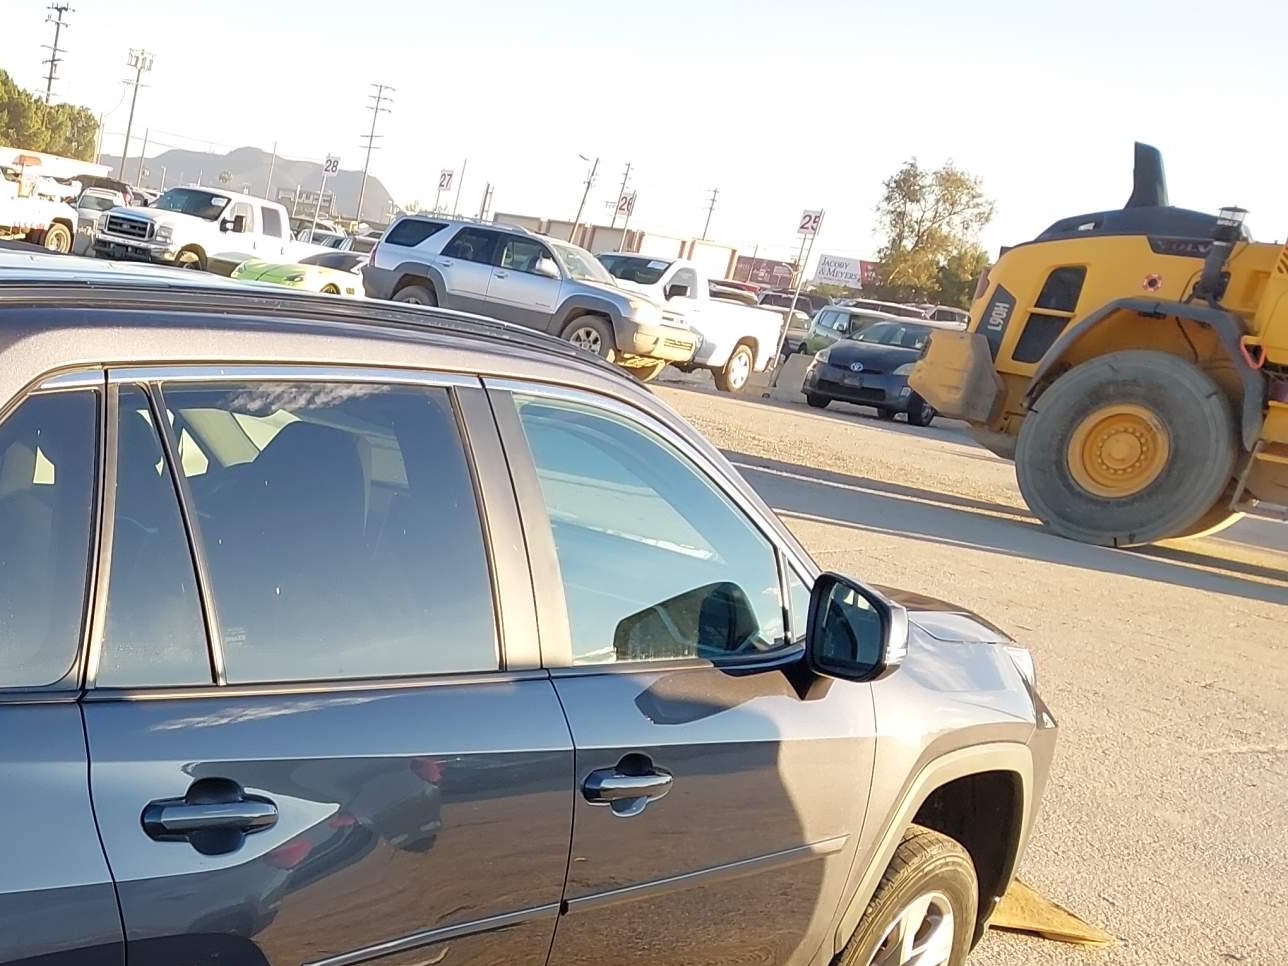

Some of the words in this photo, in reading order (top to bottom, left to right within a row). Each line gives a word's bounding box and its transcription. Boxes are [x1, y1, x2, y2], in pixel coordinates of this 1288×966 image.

[324, 159, 339, 173] 28
[439, 173, 453, 188] 27
[986, 302, 1011, 332] L90H
